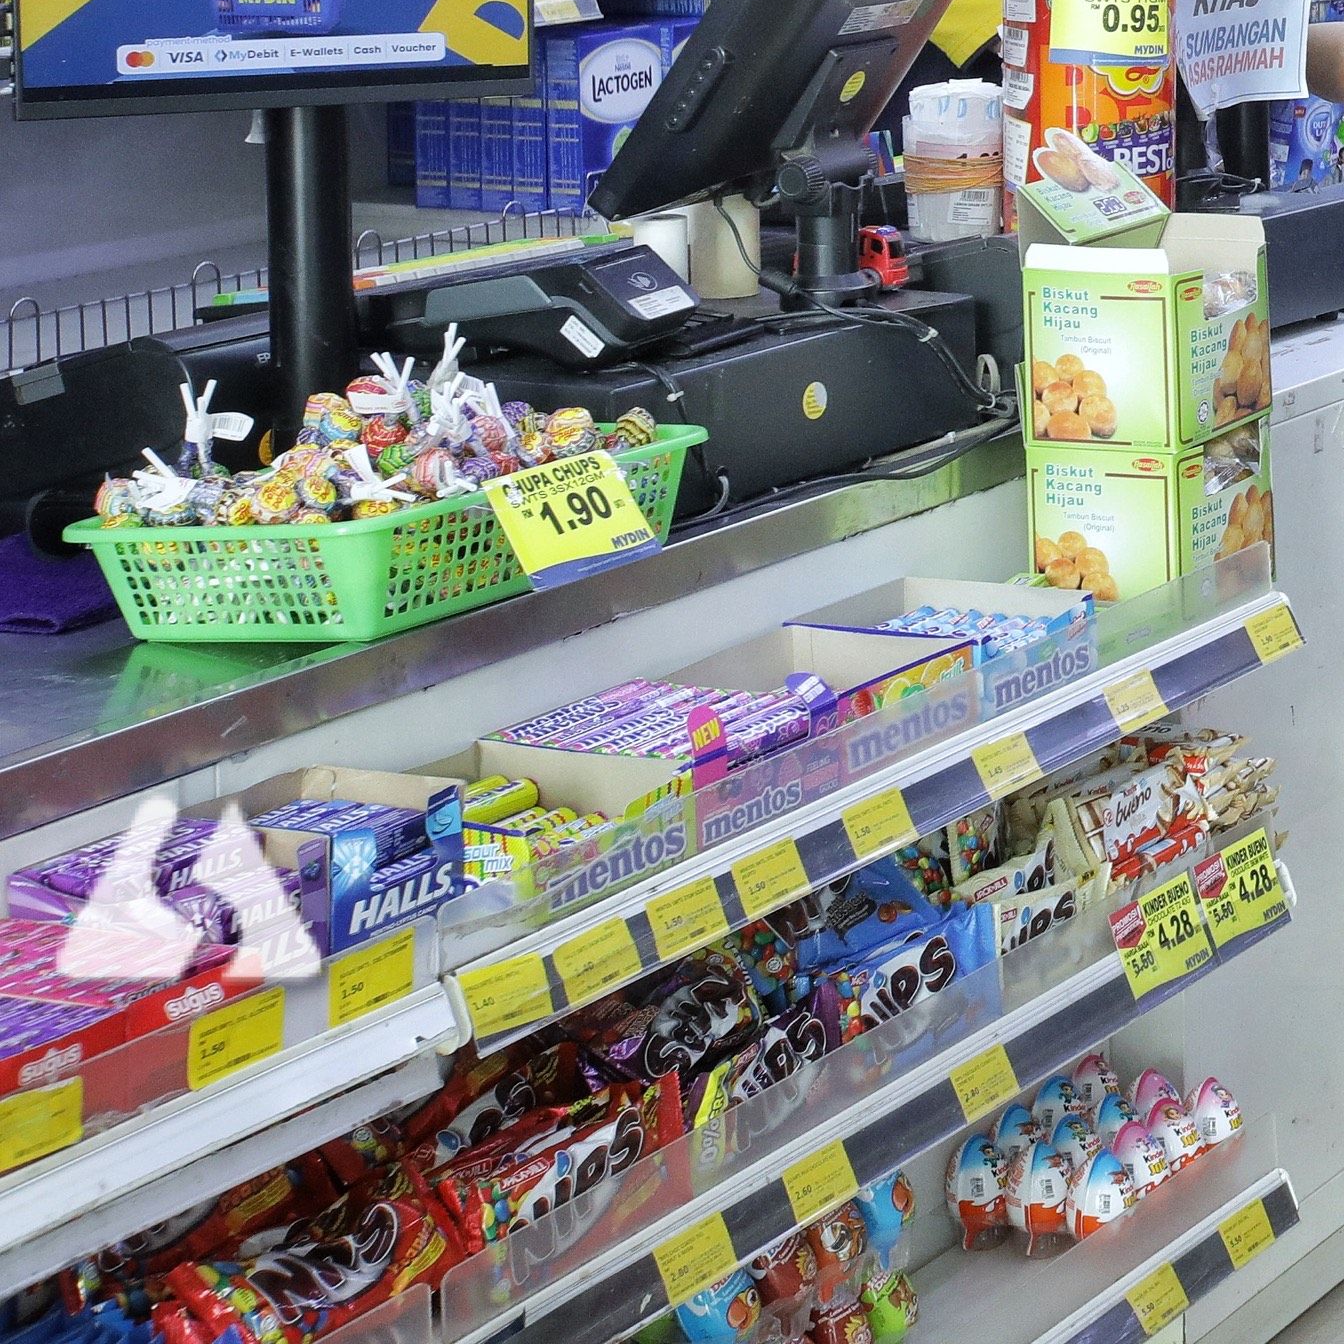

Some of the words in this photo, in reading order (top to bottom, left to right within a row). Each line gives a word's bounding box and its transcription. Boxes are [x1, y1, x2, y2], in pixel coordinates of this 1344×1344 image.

[1102, 4, 1160, 33] 0.95
[1134, 45, 1165, 55] MYDIN
[1186, 18, 1287, 59] SUMBANGAN
[168, 51, 204, 64] VISA
[229, 48, 279, 61] MyDebit
[290, 46, 344, 58] E-Wallets
[354, 44, 381, 55] Cash
[391, 42, 437, 53] Voucher
[1188, 61, 1215, 87] ASAS
[1215, 46, 1285, 80] RAHMAH
[1114, 143, 1169, 175] BEST
[1042, 286, 1090, 302] Biskut
[1043, 302, 1099, 319] Kacang
[1043, 316, 1081, 331] Hijau
[1190, 323, 1223, 343] Biskut
[1190, 338, 1228, 360] Kacang
[1190, 356, 1219, 377] Hijau
[502, 472, 553, 497] CHUPA
[552, 457, 601, 482] CHUPS
[551, 472, 606, 496] 3SX12GM
[1045, 463, 1094, 480] Biskut
[1046, 480, 1102, 496] Kacang
[1046, 492, 1085, 509] Hijau
[540, 485, 612, 535] 1.90
[1191, 498, 1223, 519] Biskut
[1191, 512, 1228, 537] Kacang
[611, 528, 650, 549] MYDIN
[1192, 532, 1217, 551] Hijau
[994, 643, 1090, 710] mentos
[693, 718, 721, 752] NEW
[846, 691, 969, 772] mentos
[703, 779, 802, 846] mentos
[1115, 786, 1153, 829] bueno
[853, 826, 872, 841] 1.50
[1226, 849, 1248, 870] KINDER
[1248, 837, 1267, 859] BUENO
[1239, 864, 1273, 904] 4.28
[348, 868, 454, 936] HALLS
[1143, 892, 1166, 917] KINDER
[1167, 881, 1189, 905] BUENO
[1158, 909, 1195, 950] 4.28
[164, 981, 224, 1022] sugus
[341, 982, 364, 999] 1.50
[19, 1042, 82, 1086] sugus
